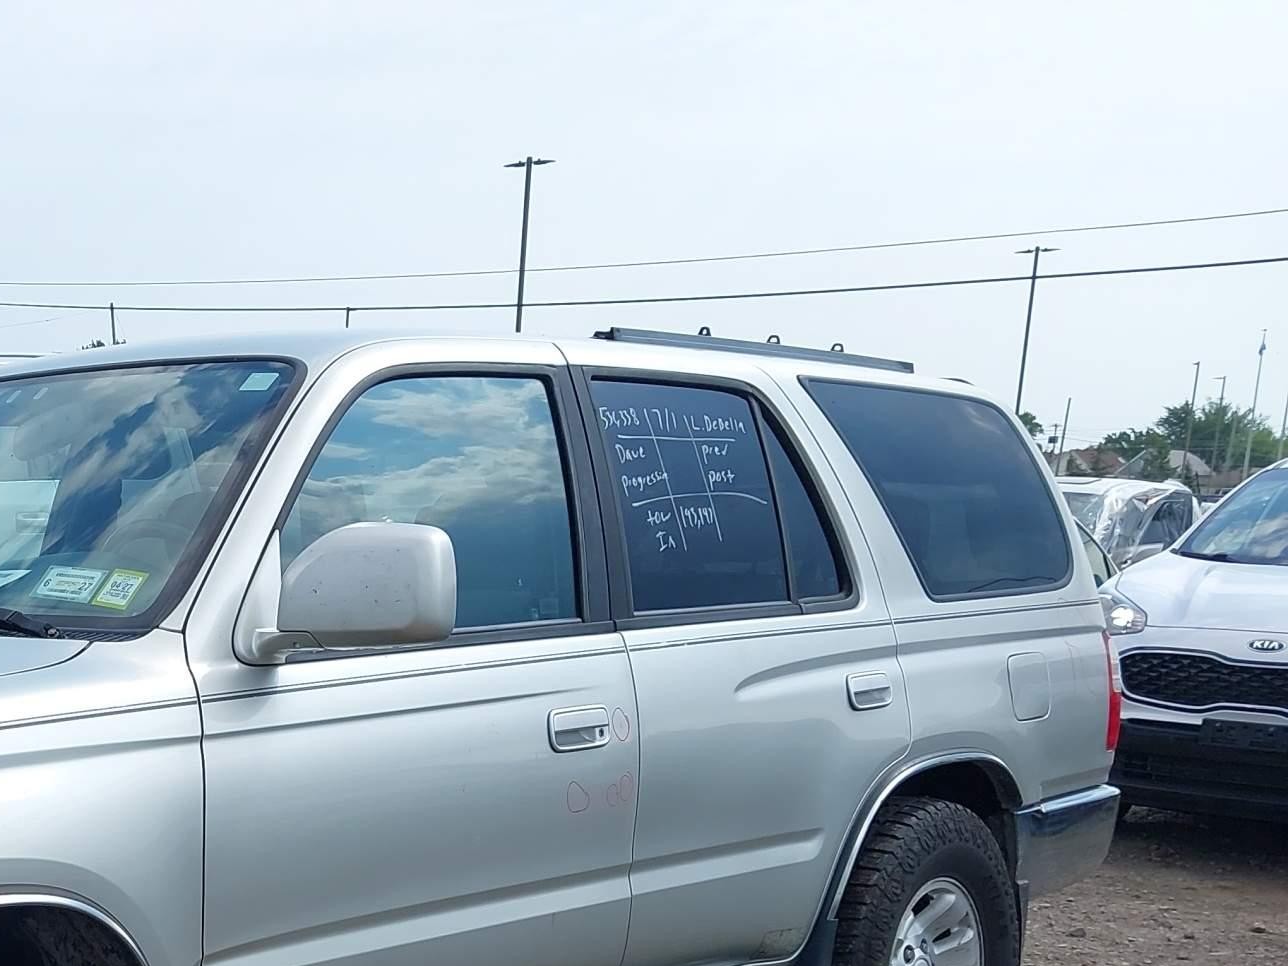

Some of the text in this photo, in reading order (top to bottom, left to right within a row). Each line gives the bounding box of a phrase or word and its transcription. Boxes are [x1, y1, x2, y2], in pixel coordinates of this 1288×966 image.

[43, 578, 52, 587] 6
[77, 582, 94, 592] 27
[1253, 640, 1279, 649] KIA
